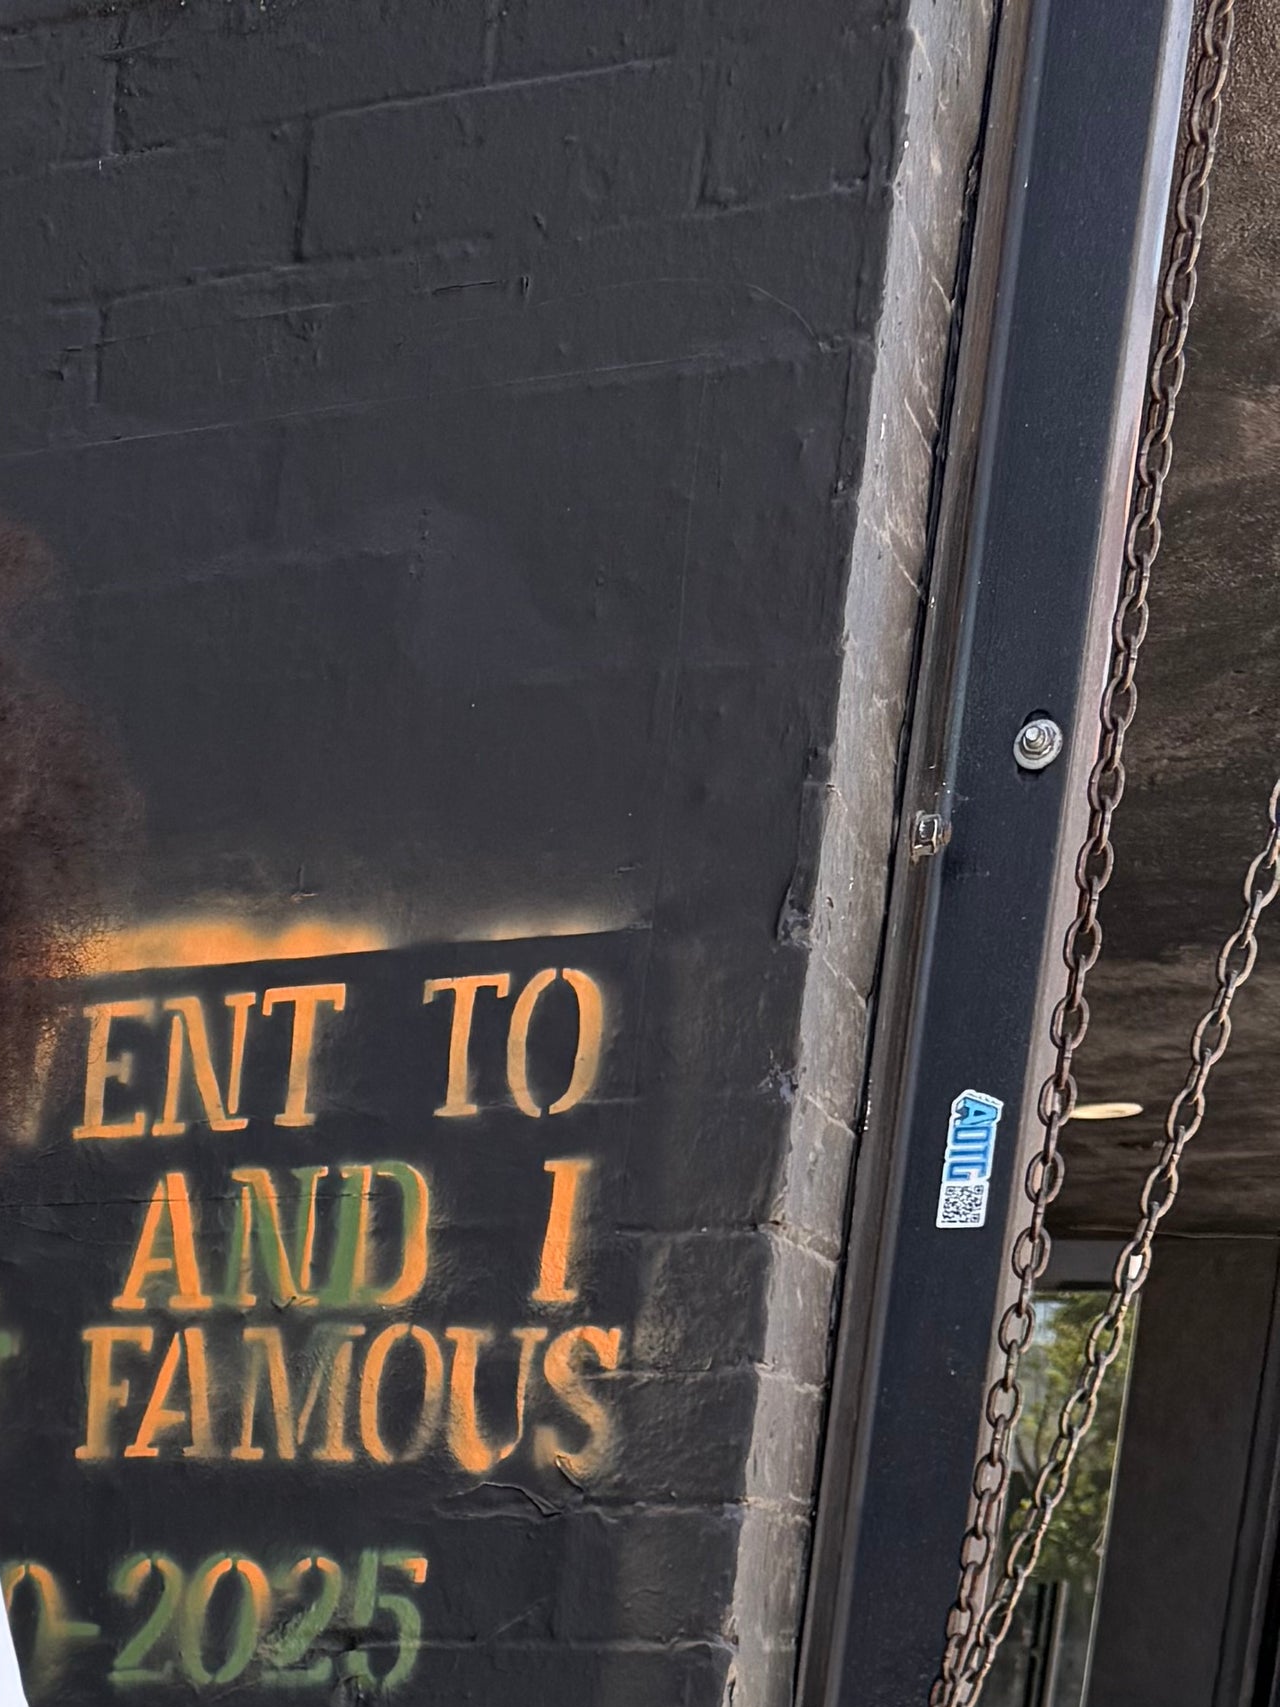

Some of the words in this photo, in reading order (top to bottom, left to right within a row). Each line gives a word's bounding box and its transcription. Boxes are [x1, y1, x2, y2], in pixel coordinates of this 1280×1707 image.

[30, 981, 347, 1140] ENT
[424, 967, 606, 1119] TO
[112, 1162, 430, 1311] AND
[534, 1159, 594, 1304] I
[75, 1323, 622, 1476] FAMOUS
